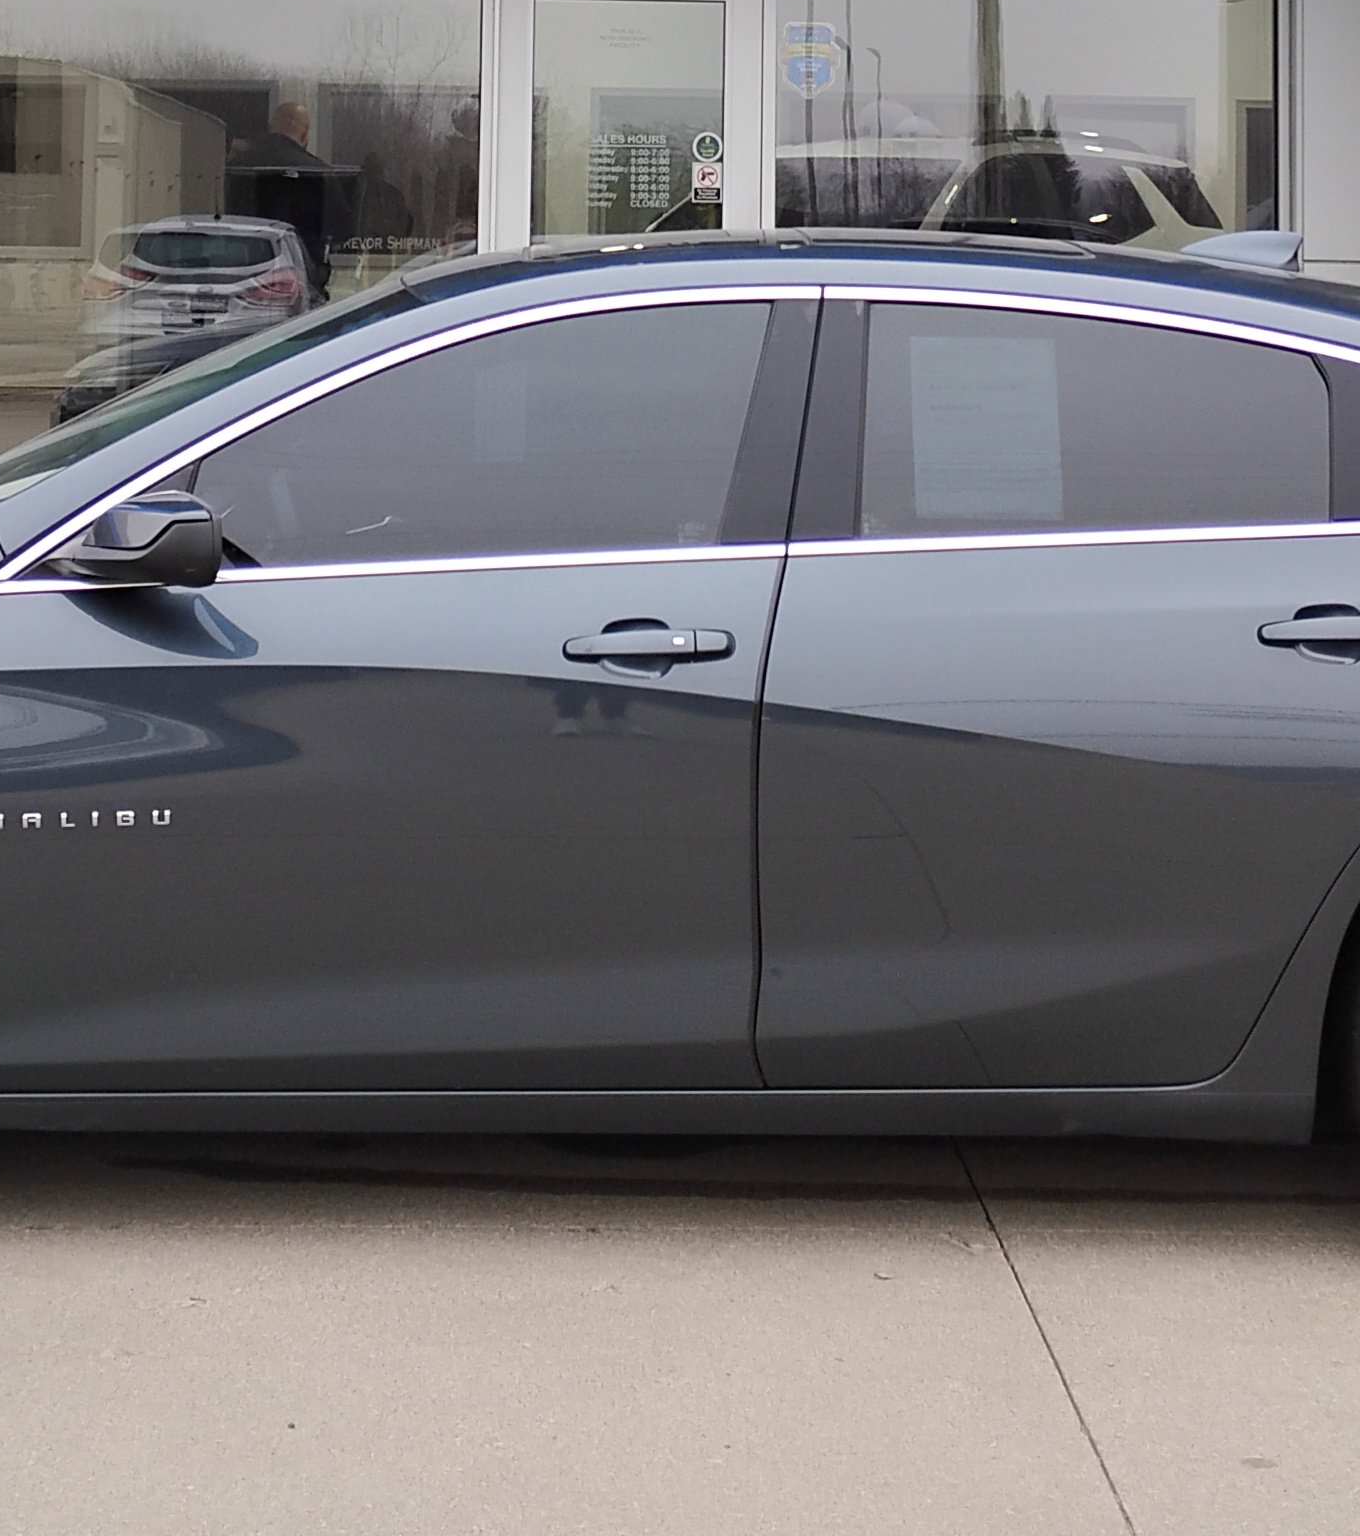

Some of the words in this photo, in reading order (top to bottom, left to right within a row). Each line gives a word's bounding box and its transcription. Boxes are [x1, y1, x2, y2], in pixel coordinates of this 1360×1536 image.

[627, 134, 667, 144] HOURS
[630, 200, 669, 208] CLOSED
[337, 237, 383, 249] REVOR
[386, 235, 440, 250] SHIPMAN
